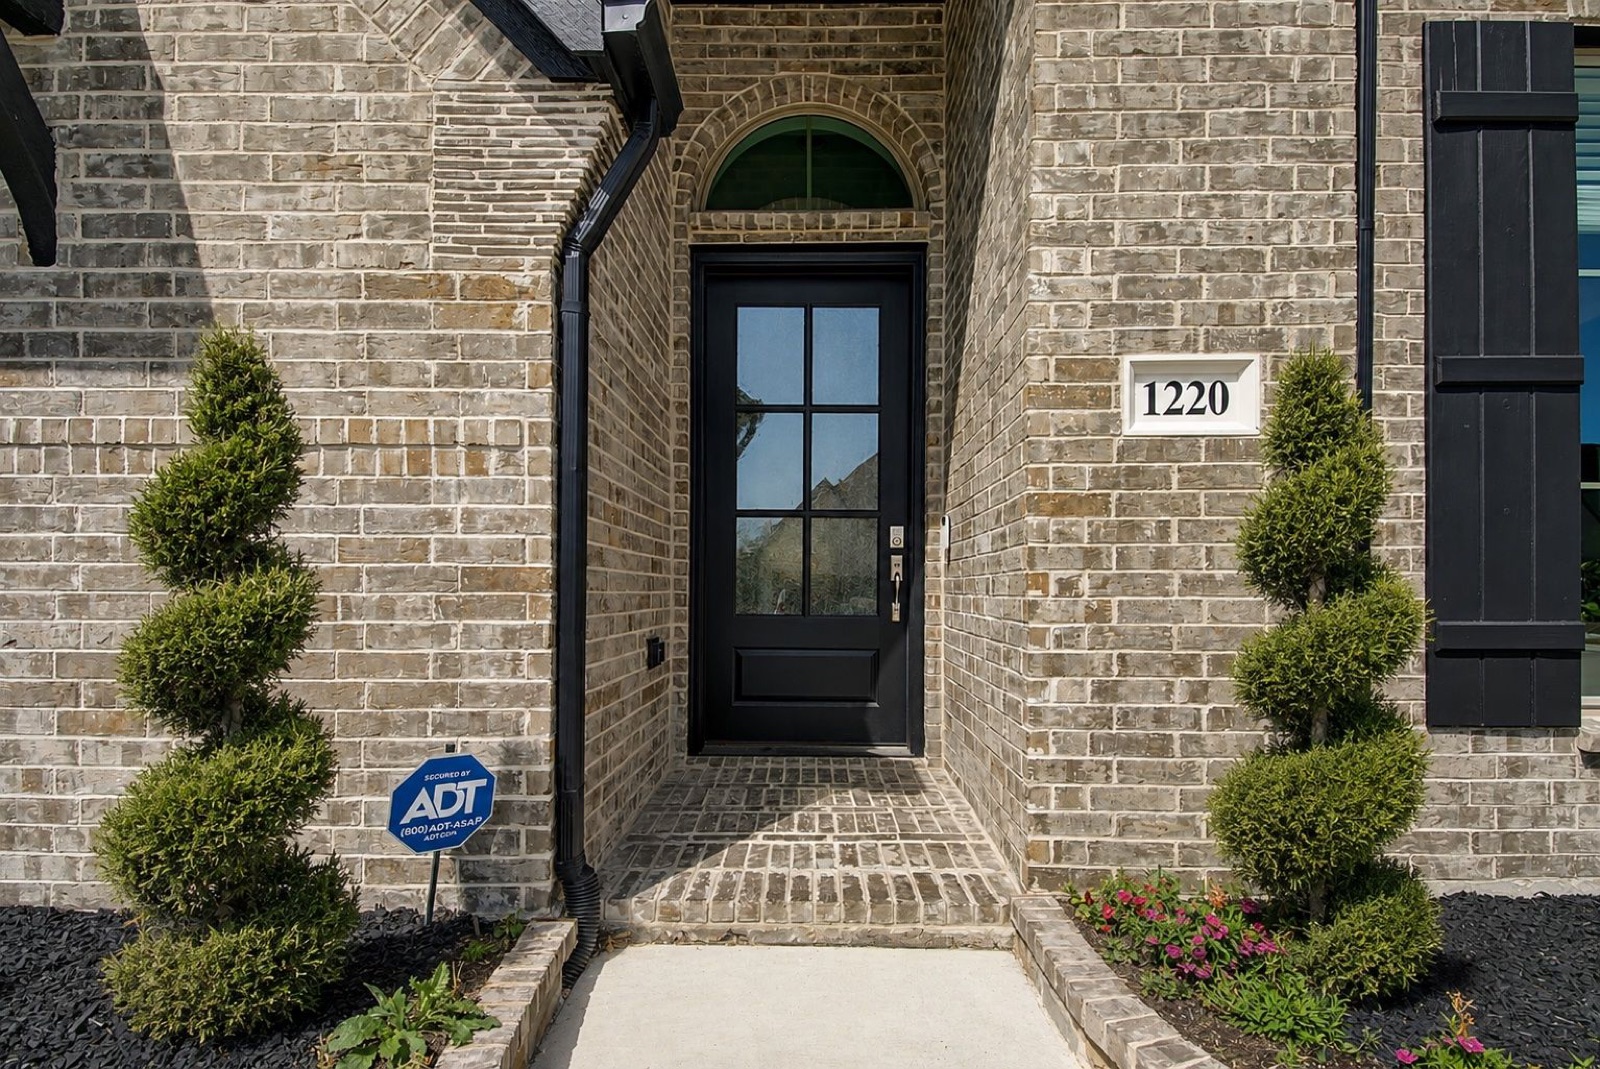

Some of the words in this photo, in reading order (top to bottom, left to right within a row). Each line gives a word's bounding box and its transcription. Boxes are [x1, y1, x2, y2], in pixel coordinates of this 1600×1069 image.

[1143, 380, 1229, 416] 1220
[424, 773, 460, 782] SECURED
[399, 779, 487, 825] ADT
[401, 825, 428, 838] (800)
[428, 816, 482, 833] ADT-ASAP
